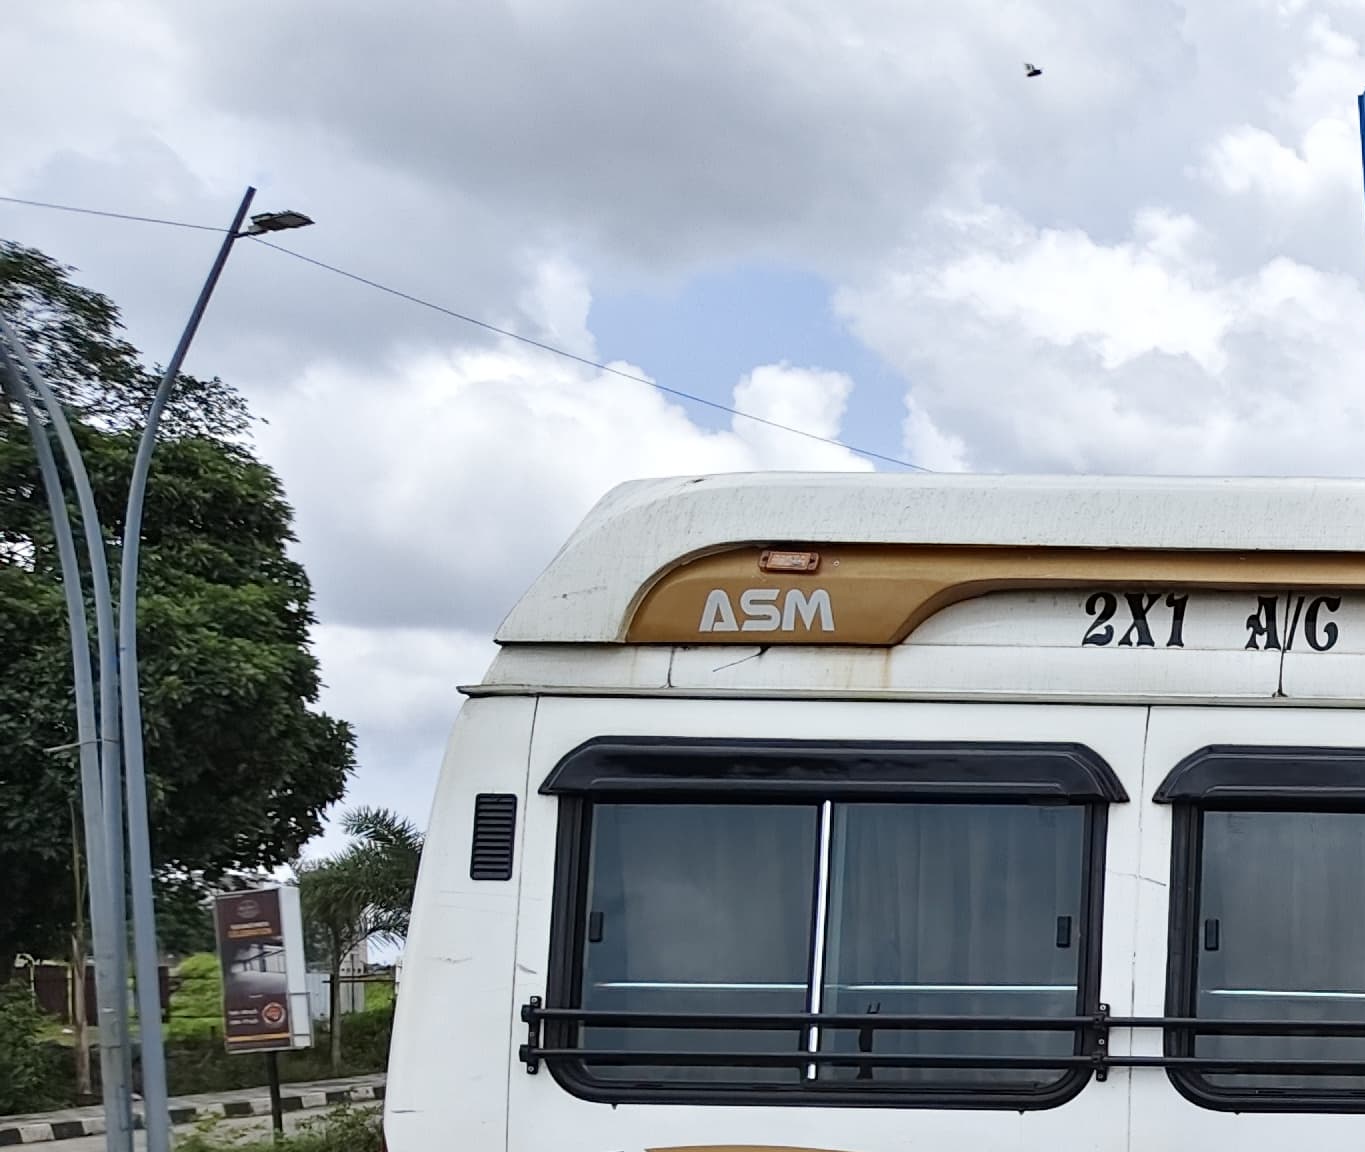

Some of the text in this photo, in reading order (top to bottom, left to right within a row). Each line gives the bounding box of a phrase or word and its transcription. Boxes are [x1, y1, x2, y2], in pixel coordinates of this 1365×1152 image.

[699, 588, 835, 633] ASM
[1082, 592, 1189, 648] 2X1
[1244, 595, 1342, 652] A/C
